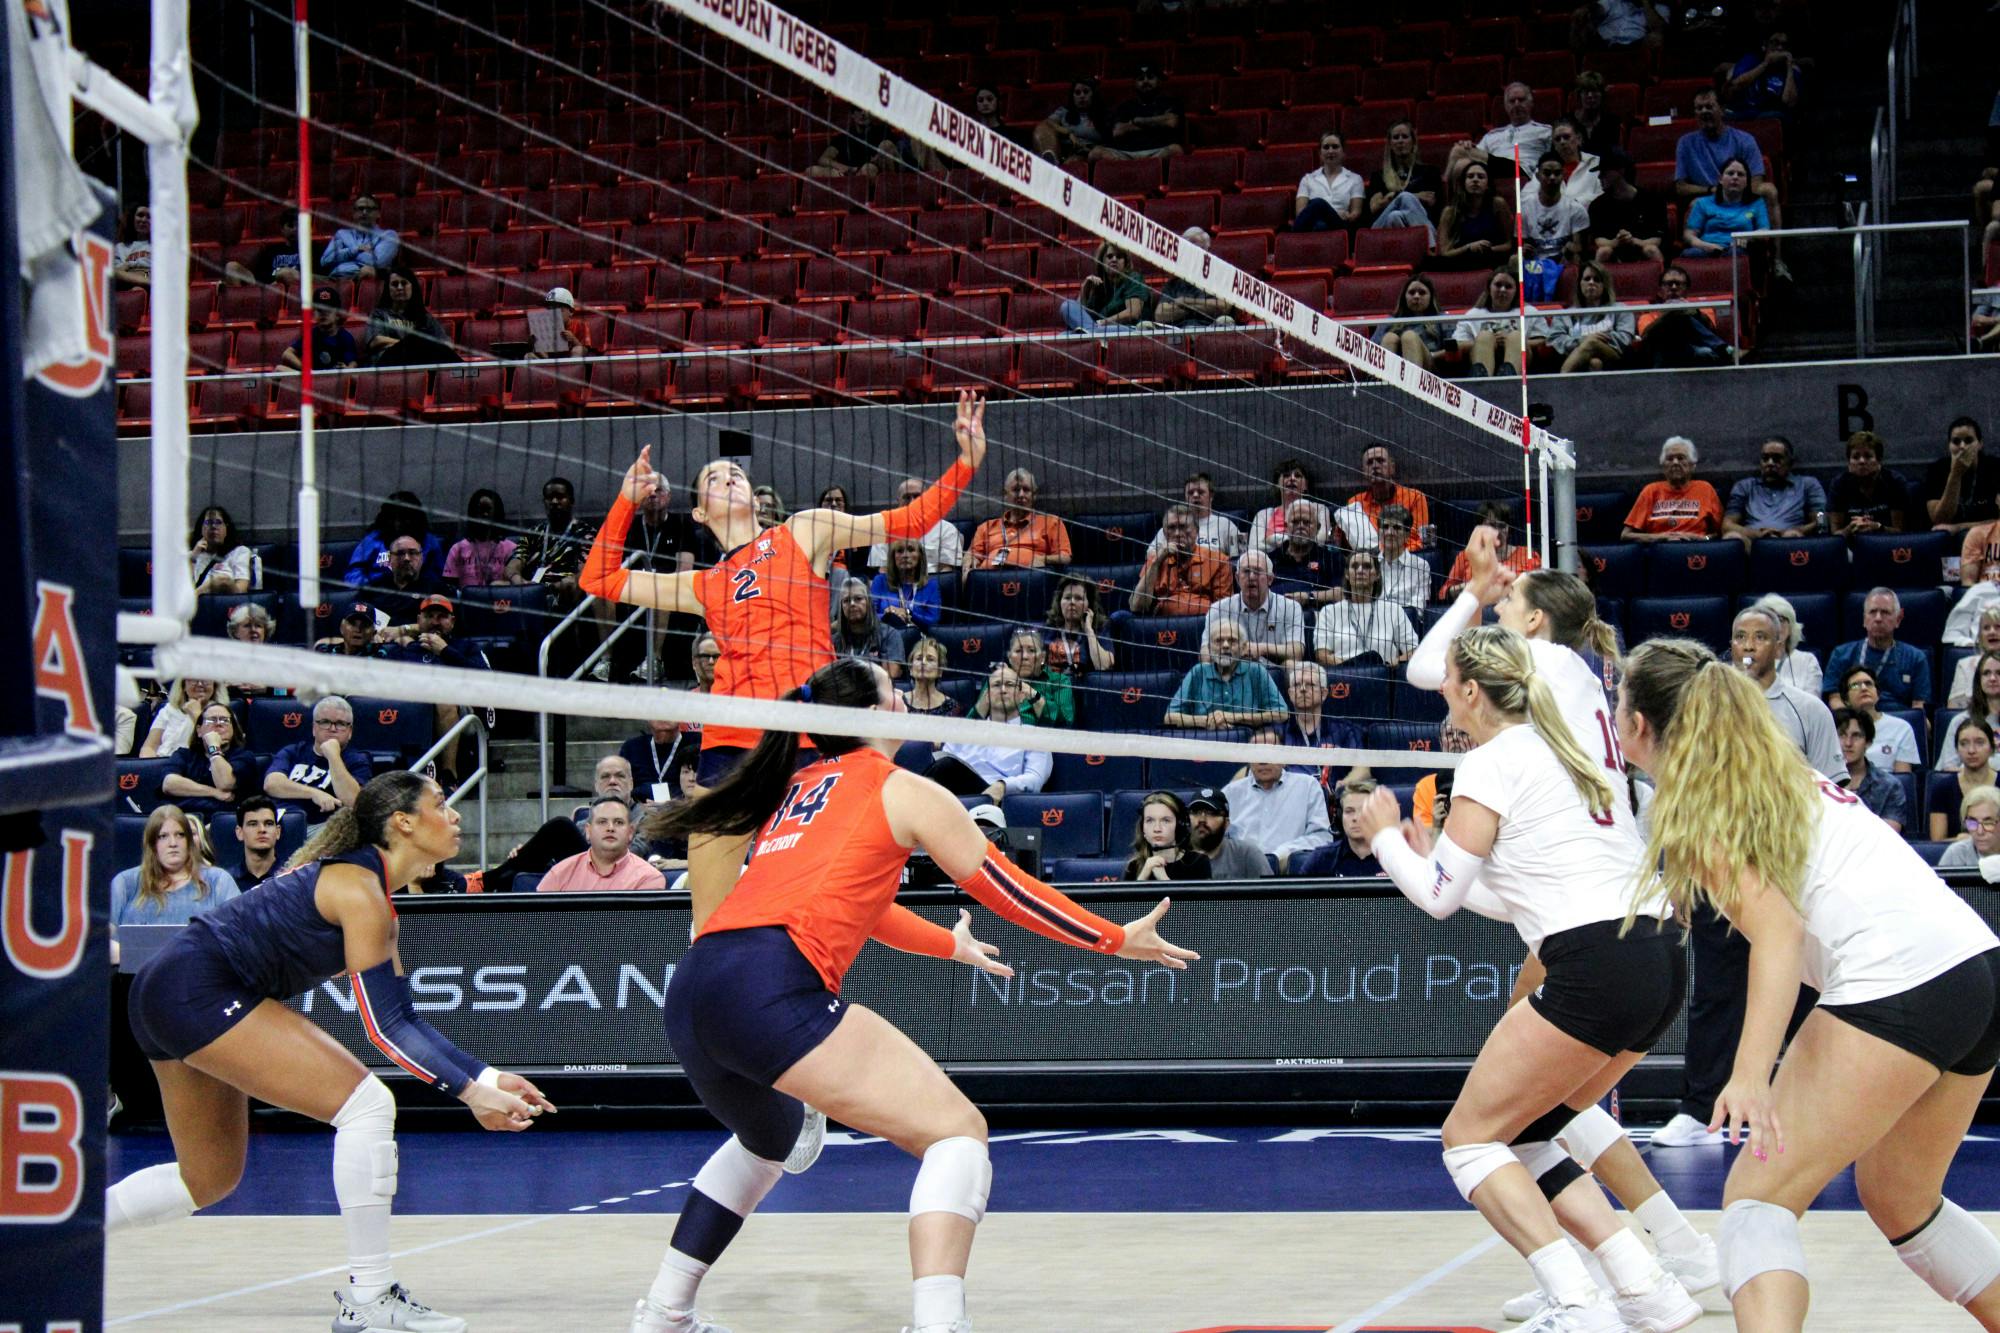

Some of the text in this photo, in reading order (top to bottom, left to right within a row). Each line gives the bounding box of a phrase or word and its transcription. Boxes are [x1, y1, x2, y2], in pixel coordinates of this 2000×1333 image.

[777, 14, 837, 76] TIGERS
[929, 101, 1033, 185] AUBURN TIGERS
[1100, 197, 1180, 263] AUBURN TIGERS
[1231, 269, 1295, 323] AUBURN TIGERS
[1335, 323, 1363, 359] AUBURN
[1364, 341, 1387, 371] TIGERS
[1838, 384, 1874, 441] B
[732, 568, 762, 604] 2
[765, 772, 843, 836] 14
[303, 965, 676, 1012] NSSAN
[971, 960, 1190, 1006] Nissan.
[1212, 953, 1400, 1003] Proud
[563, 1064, 628, 1072] DAKTRONICS
[1275, 1058, 1344, 1066] DAKTRONICS
